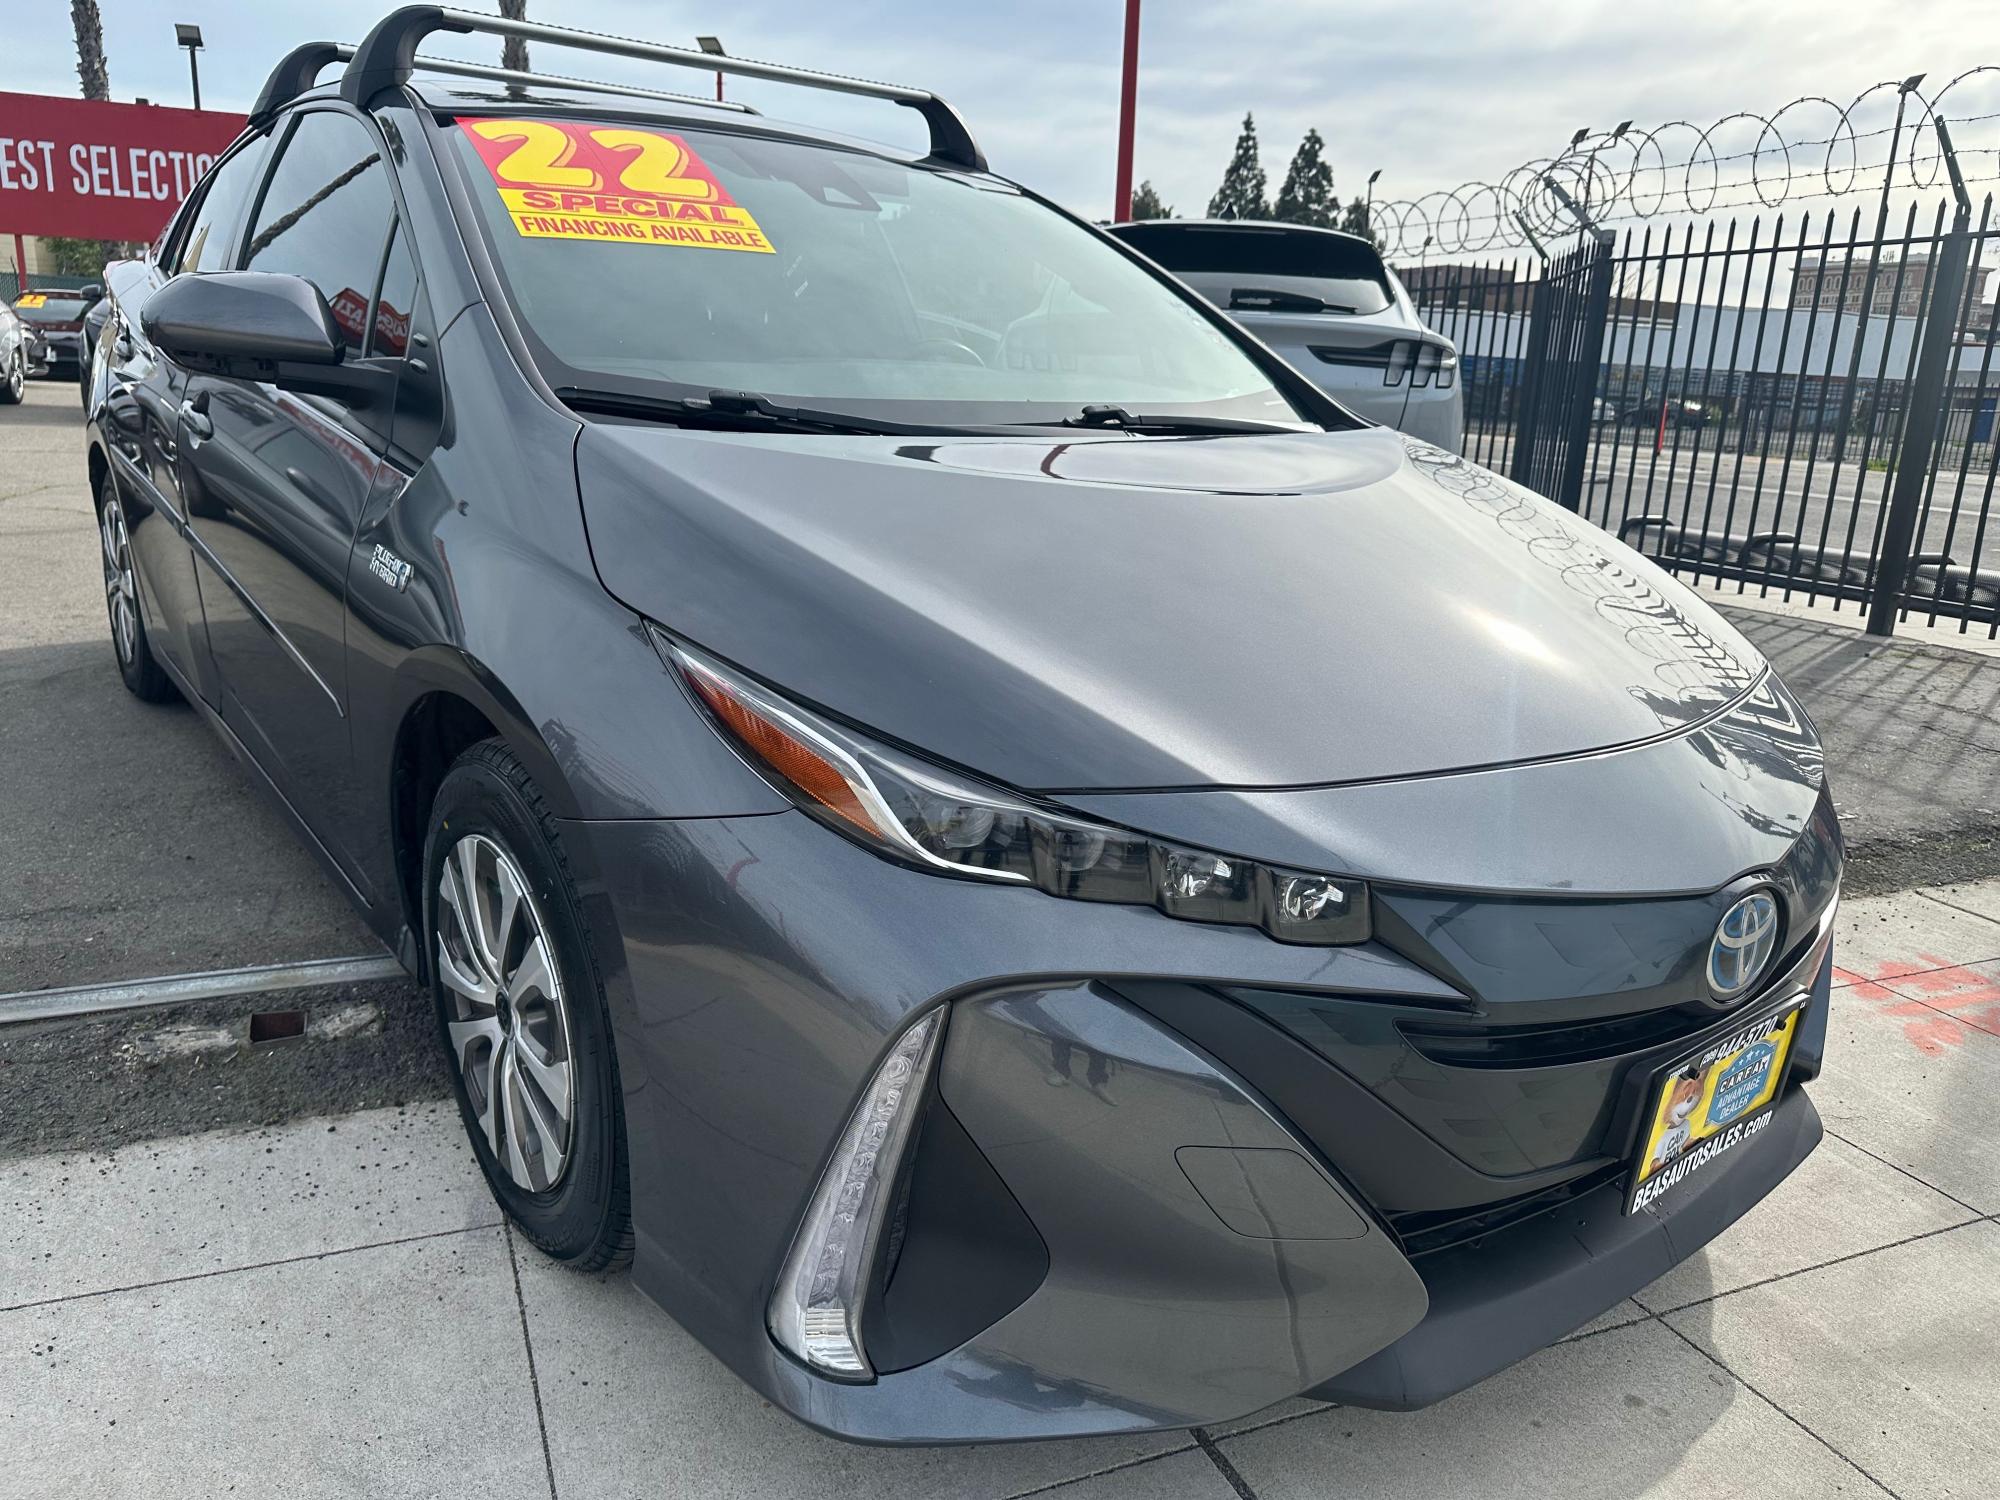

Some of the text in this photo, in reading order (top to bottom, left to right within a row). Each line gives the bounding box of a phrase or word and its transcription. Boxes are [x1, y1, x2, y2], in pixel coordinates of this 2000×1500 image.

[69, 143, 219, 202] SELECTIO
[471, 120, 718, 202] 22
[522, 191, 744, 226] SPECIAL
[519, 217, 767, 249] FINANCING AVAILABLE
[1713, 1015, 1779, 1065] 944-5770
[1719, 1054, 1771, 1094] CARFAX
[1715, 1077, 1761, 1110] ADVANTAGE
[1719, 1094, 1750, 1120] DEALER
[1666, 1129, 1685, 1152] CAR
[1631, 1110, 1773, 1214] BEASAUTOSALES.com
